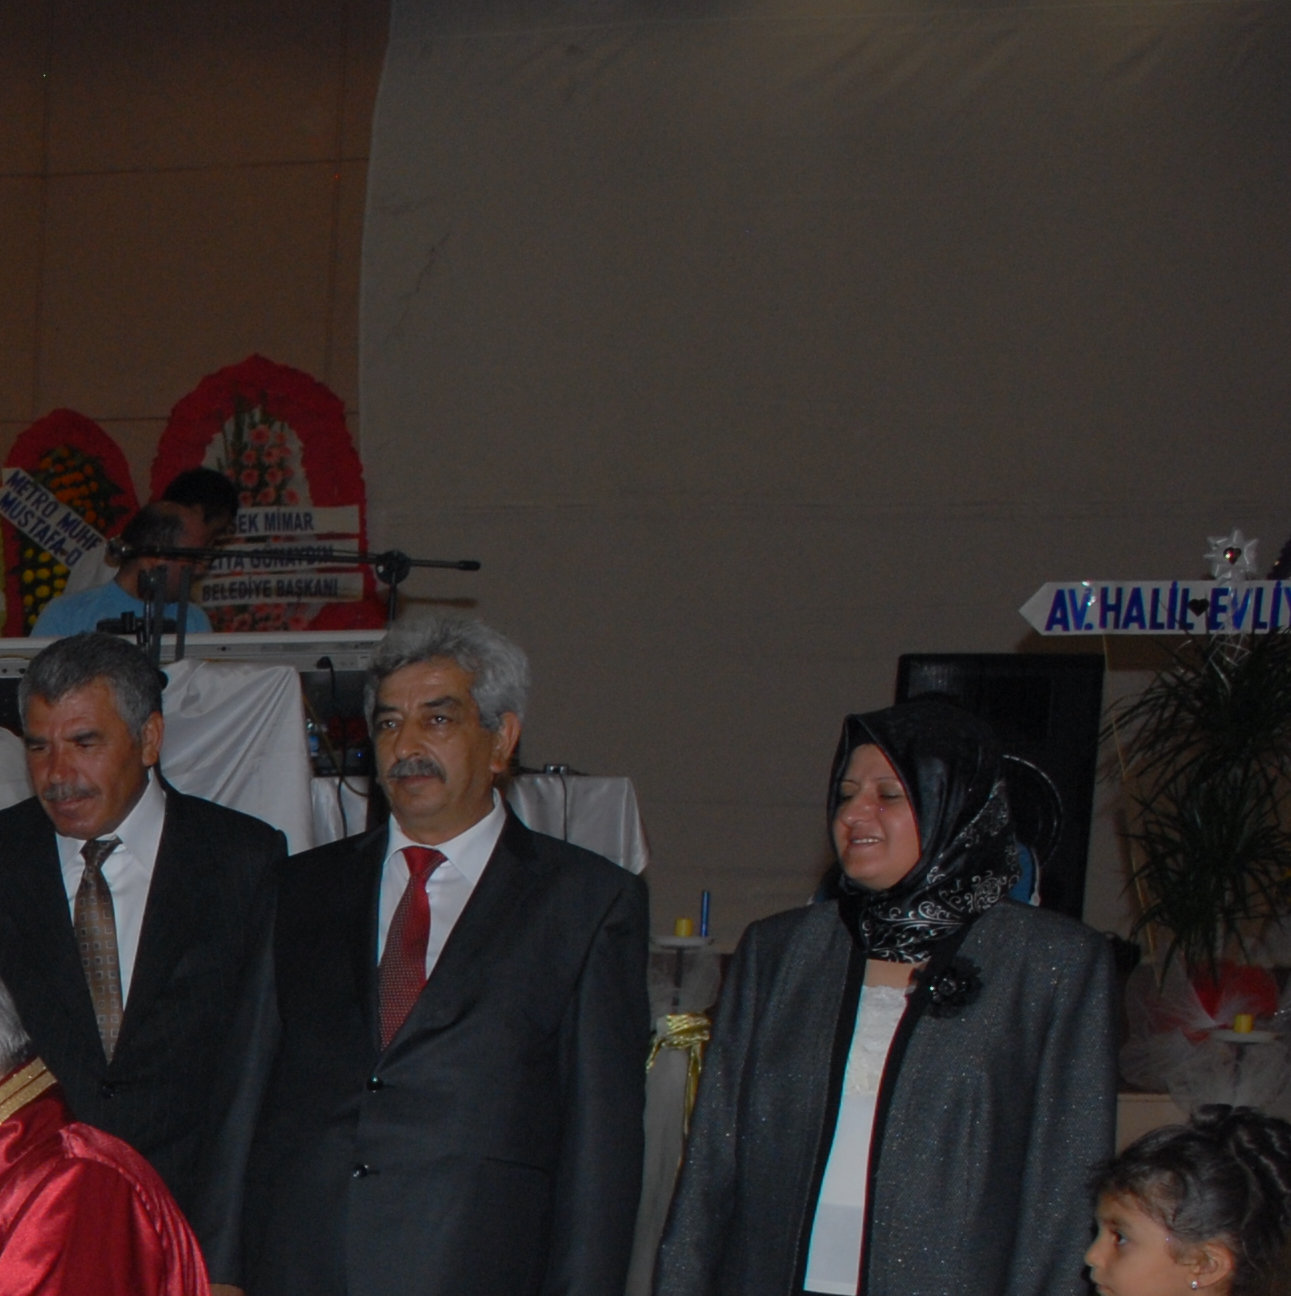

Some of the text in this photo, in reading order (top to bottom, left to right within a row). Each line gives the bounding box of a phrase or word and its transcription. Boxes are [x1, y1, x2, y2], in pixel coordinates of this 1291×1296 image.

[5, 469, 59, 518] METRO
[264, 508, 314, 531] MİMAR
[202, 577, 272, 602] BELEDİYE
